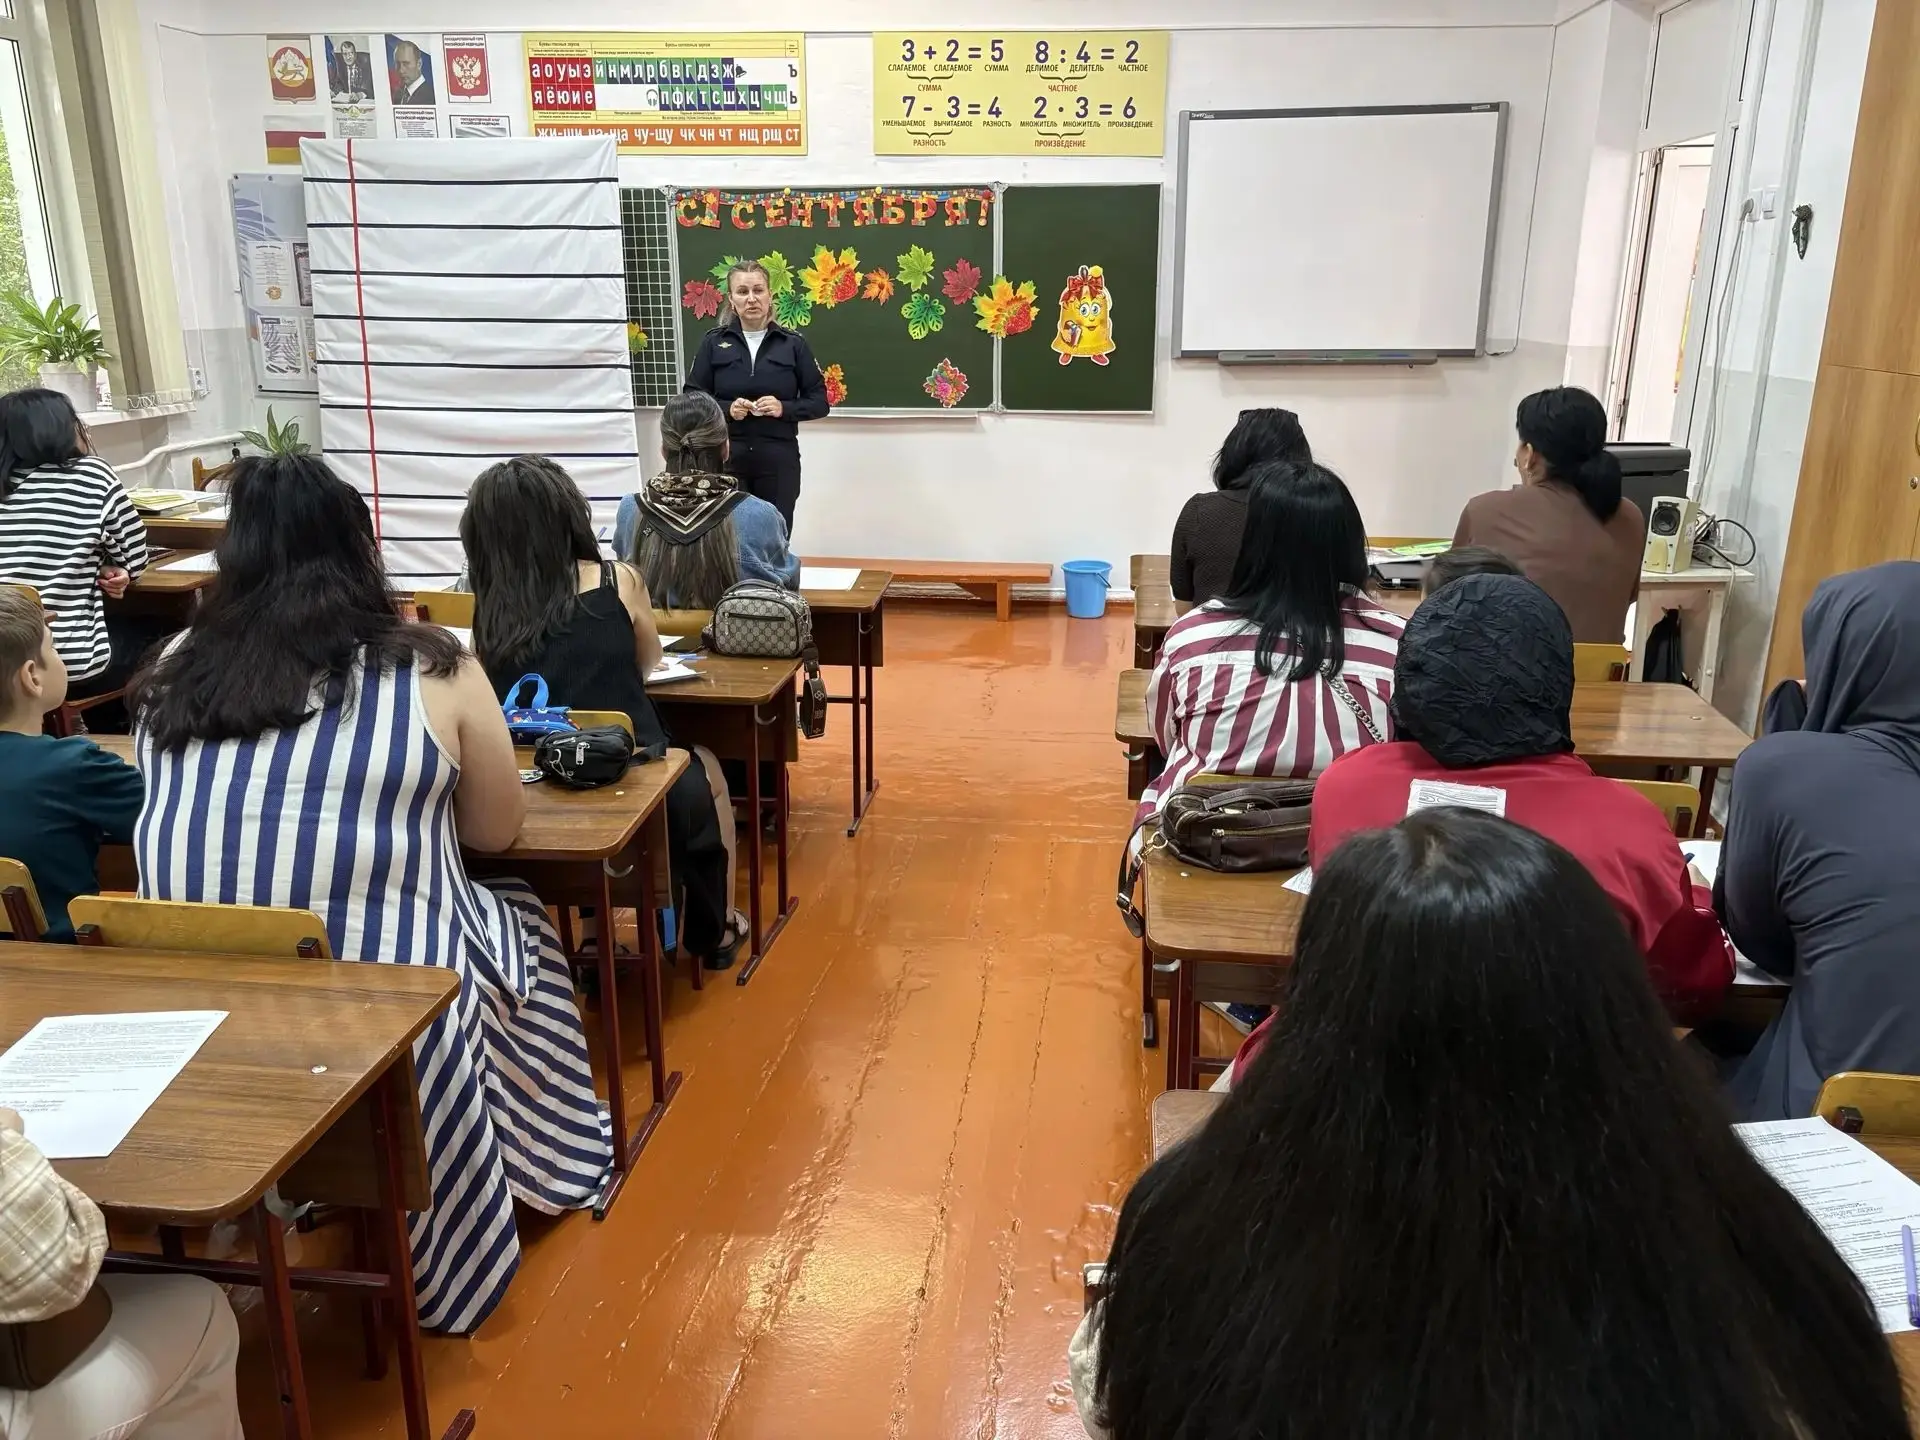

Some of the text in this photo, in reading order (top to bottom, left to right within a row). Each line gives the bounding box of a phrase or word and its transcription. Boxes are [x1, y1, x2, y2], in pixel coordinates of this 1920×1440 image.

[902, 39, 1003, 62] 3 + 2 = 5
[1036, 41, 1048, 63] 8
[1076, 41, 1091, 63] 4
[1101, 49, 1114, 59] =
[1125, 40, 1138, 63] 2
[532, 60, 733, 82] а о у ы э й н м л р б в г д з ж
[1026, 64, 1058, 72] ДЕЛИМОЕ
[1070, 64, 1104, 72] ДЕЛИТЕЛЬ
[535, 87, 787, 108] я ё ю и е п ф к т с ш х ц ч щ
[903, 96, 915, 118] 7
[947, 96, 959, 118] 3
[968, 104, 980, 114] =
[988, 96, 1002, 118] 4
[1034, 96, 1047, 118] 2
[1076, 97, 1088, 118] 3
[1099, 104, 1112, 115] =
[1123, 97, 1136, 119] 6
[635, 128, 673, 144] чу-щу
[680, 128, 696, 141] чк
[700, 128, 714, 141] чн
[719, 128, 733, 141] чт
[740, 128, 759, 143] нщ
[763, 128, 782, 144] рщ
[1035, 140, 1085, 148] ПРОИЗВЕДЕНИЕ
[731, 193, 990, 229] СЕНТЯБРЯ!
